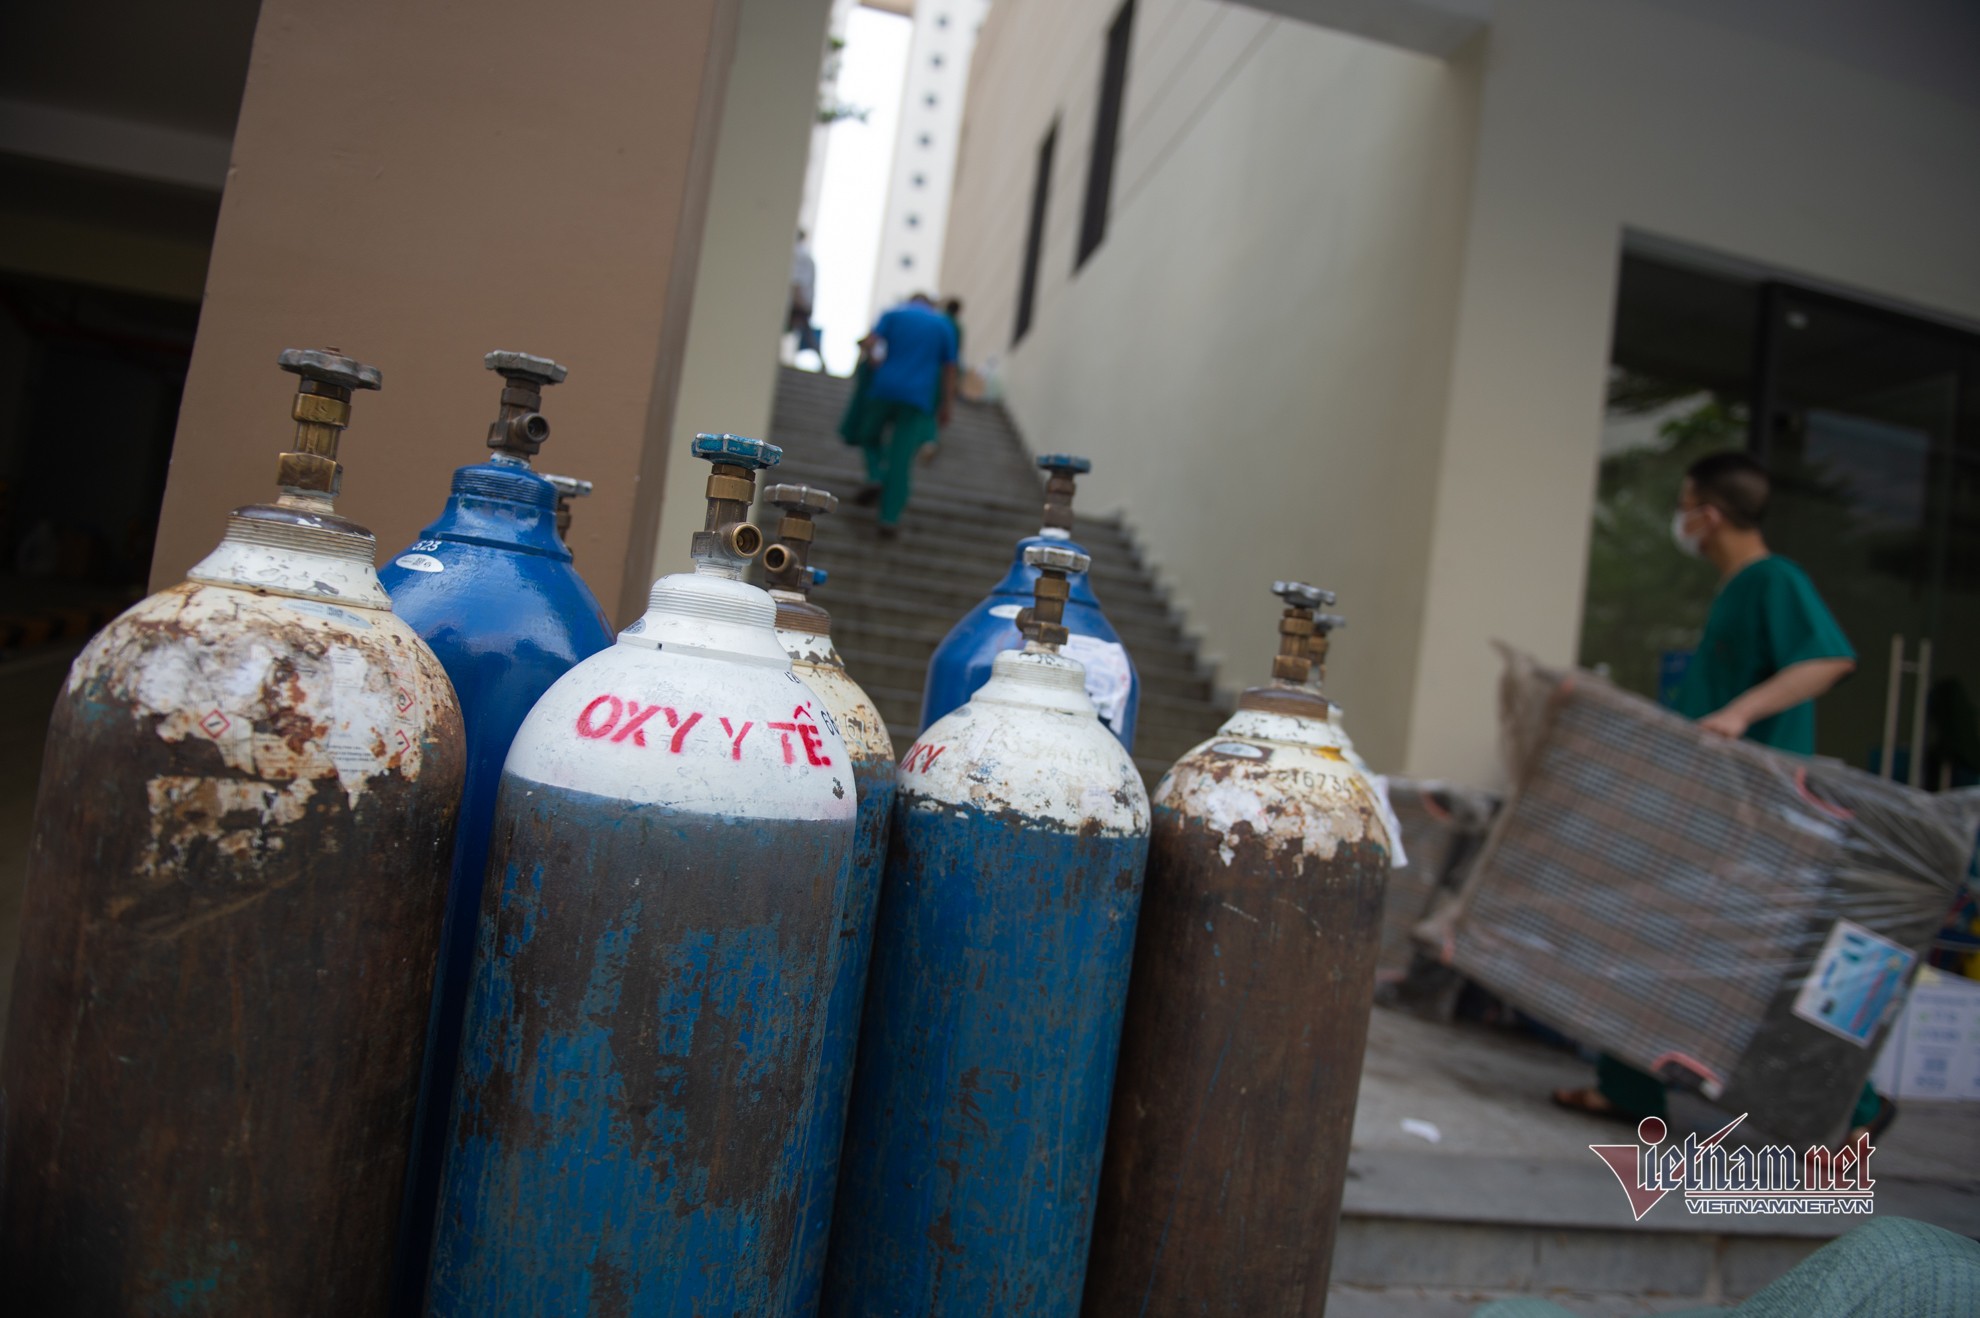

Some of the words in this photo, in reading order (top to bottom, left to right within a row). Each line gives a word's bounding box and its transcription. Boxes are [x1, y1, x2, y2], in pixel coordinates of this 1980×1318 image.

[576, 694, 704, 754] OXY
[718, 716, 755, 761] Y
[766, 700, 832, 766] TẾ
